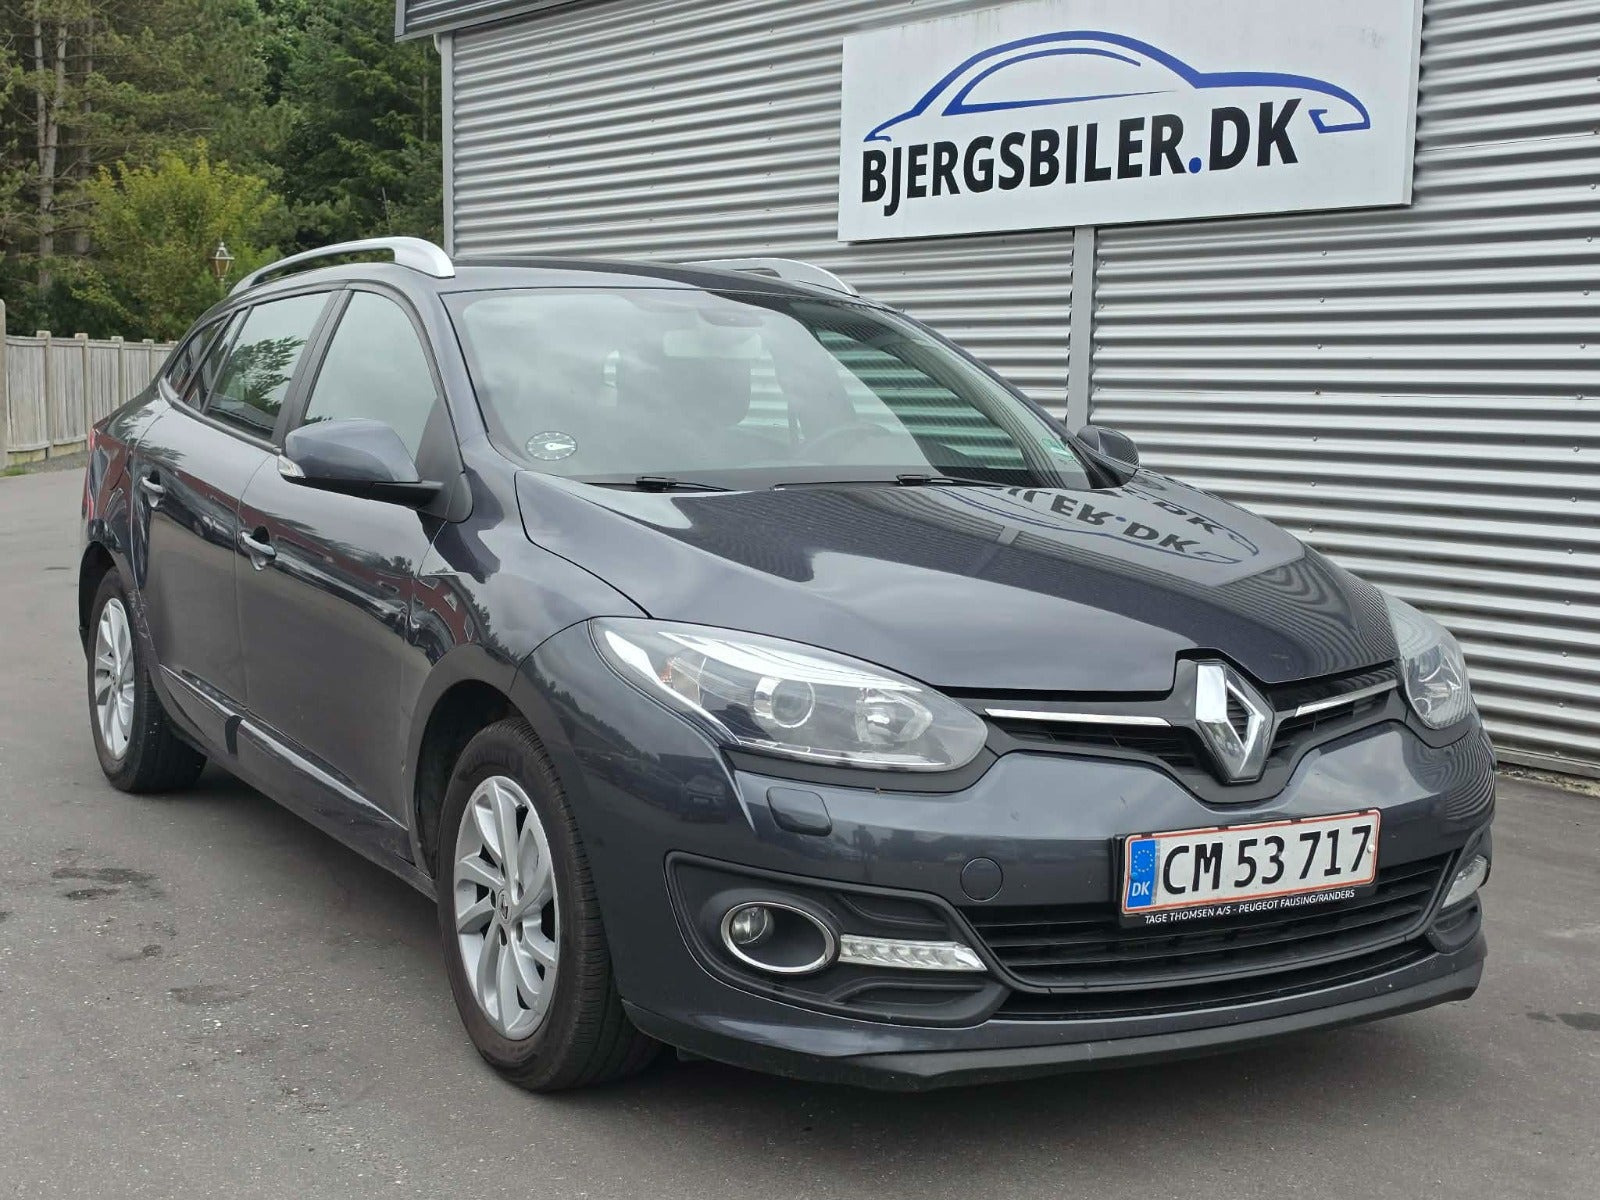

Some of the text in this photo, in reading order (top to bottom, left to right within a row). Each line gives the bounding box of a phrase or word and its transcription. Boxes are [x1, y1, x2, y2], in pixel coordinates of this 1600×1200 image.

[861, 98, 1302, 217] BJERGSBILER.DK
[1162, 824, 1372, 895] CM 53 717
[1131, 880, 1151, 897] DK
[1144, 913, 1168, 925] TAGE
[1170, 908, 1214, 921] THOMSEN
[1215, 905, 1231, 917] A/S
[1238, 899, 1279, 914] PEUGEOT
[1280, 889, 1356, 908] FAUSING/RANDERS
